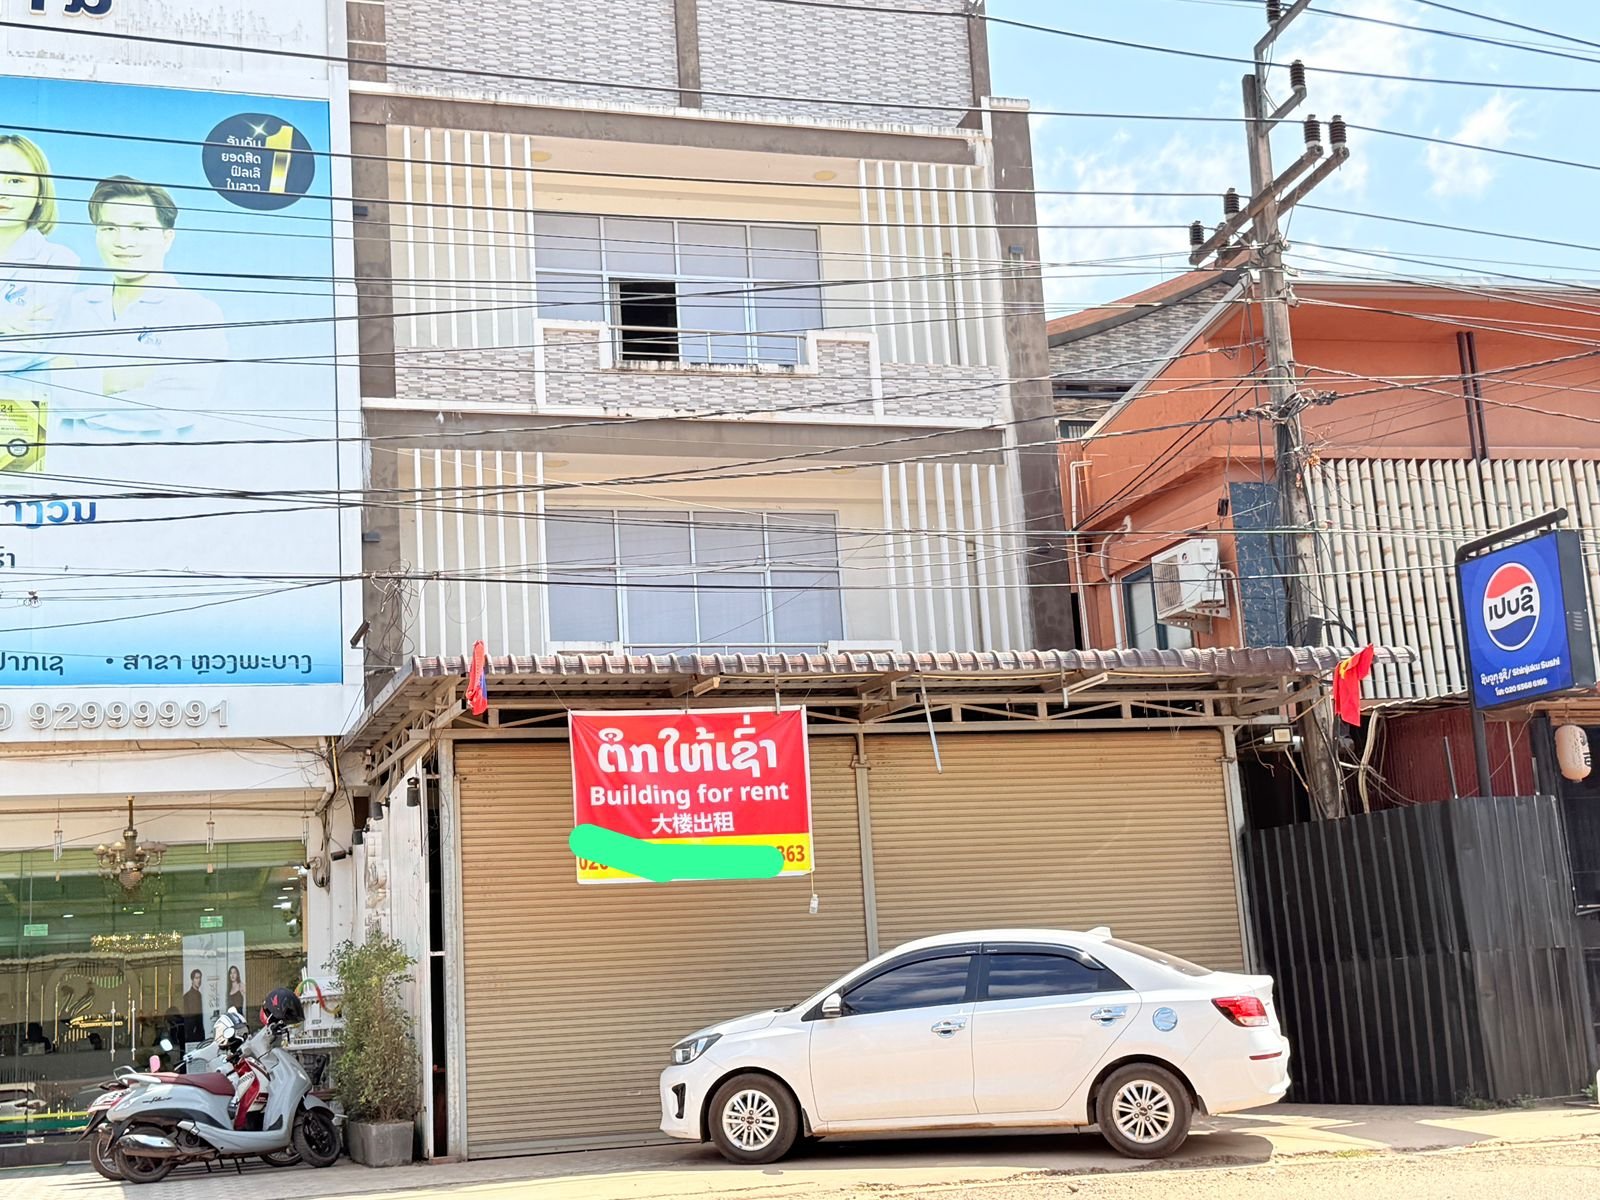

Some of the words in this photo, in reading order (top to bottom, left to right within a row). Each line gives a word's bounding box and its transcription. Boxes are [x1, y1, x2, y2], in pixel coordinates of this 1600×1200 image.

[123, 654, 182, 671] ສາຂາ
[1541, 656, 1560, 669] Sushi
[28, 700, 230, 730] 92999991
[590, 783, 691, 810] Building
[697, 783, 733, 804] for
[740, 782, 789, 802] rent
[651, 811, 735, 834] 大楼出租
